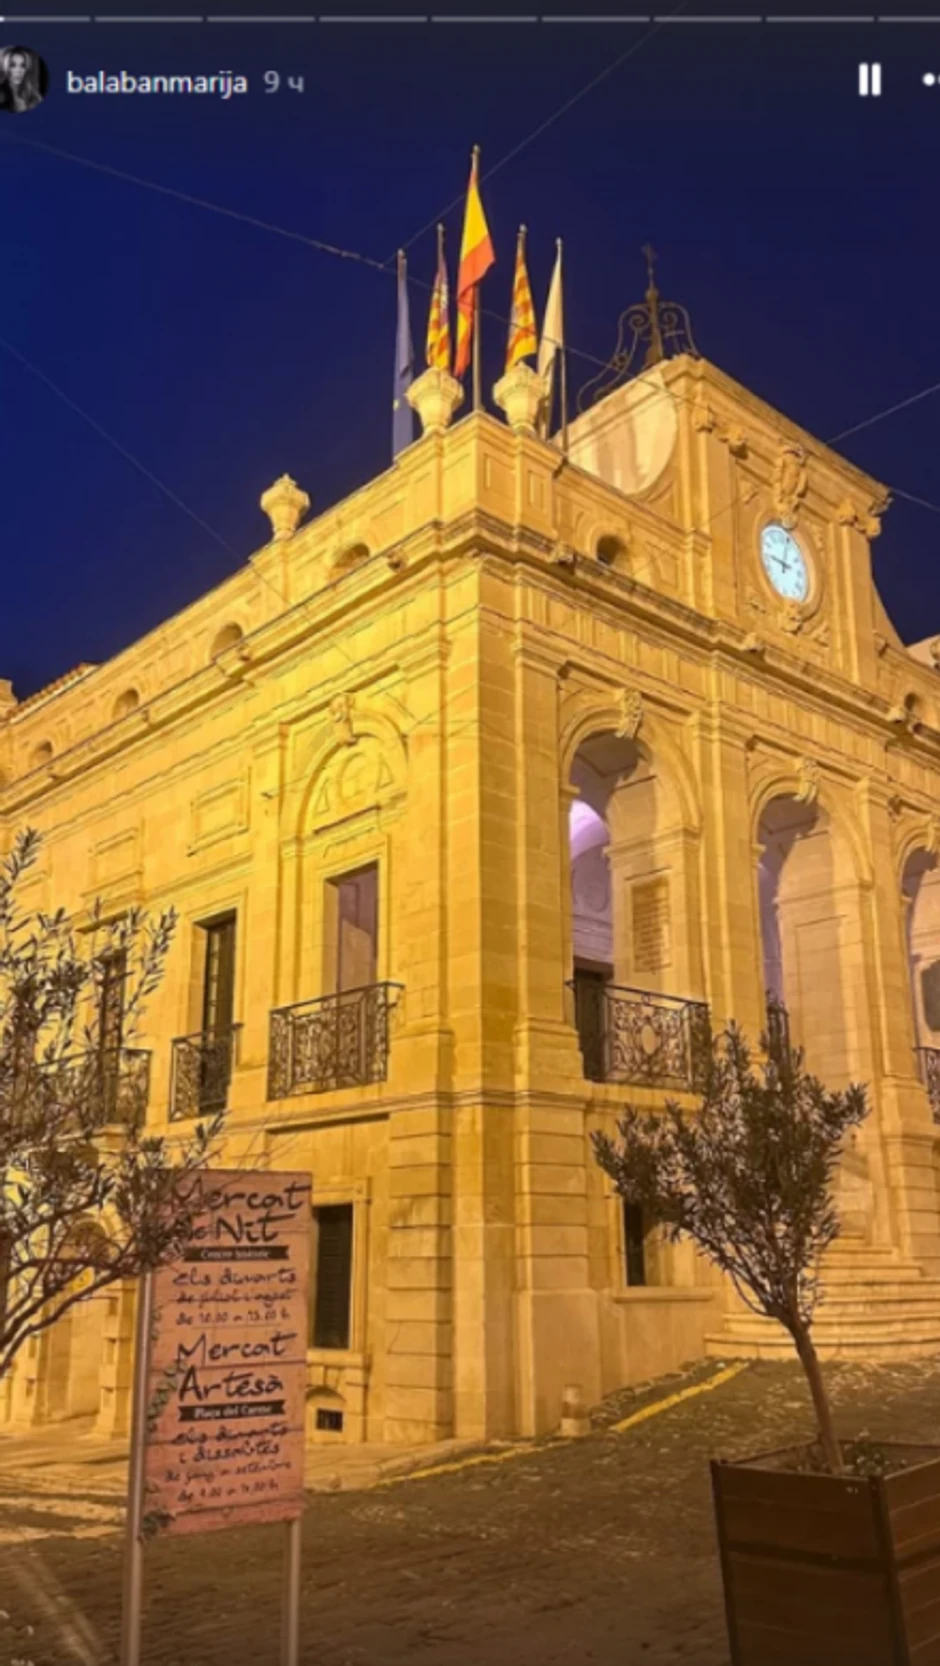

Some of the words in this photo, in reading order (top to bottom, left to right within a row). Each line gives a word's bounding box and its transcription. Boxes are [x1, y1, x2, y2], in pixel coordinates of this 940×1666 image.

[216, 1211, 296, 1242] Nit
[177, 1331, 297, 1369] Mercat
[179, 1365, 283, 1401] Artesà
